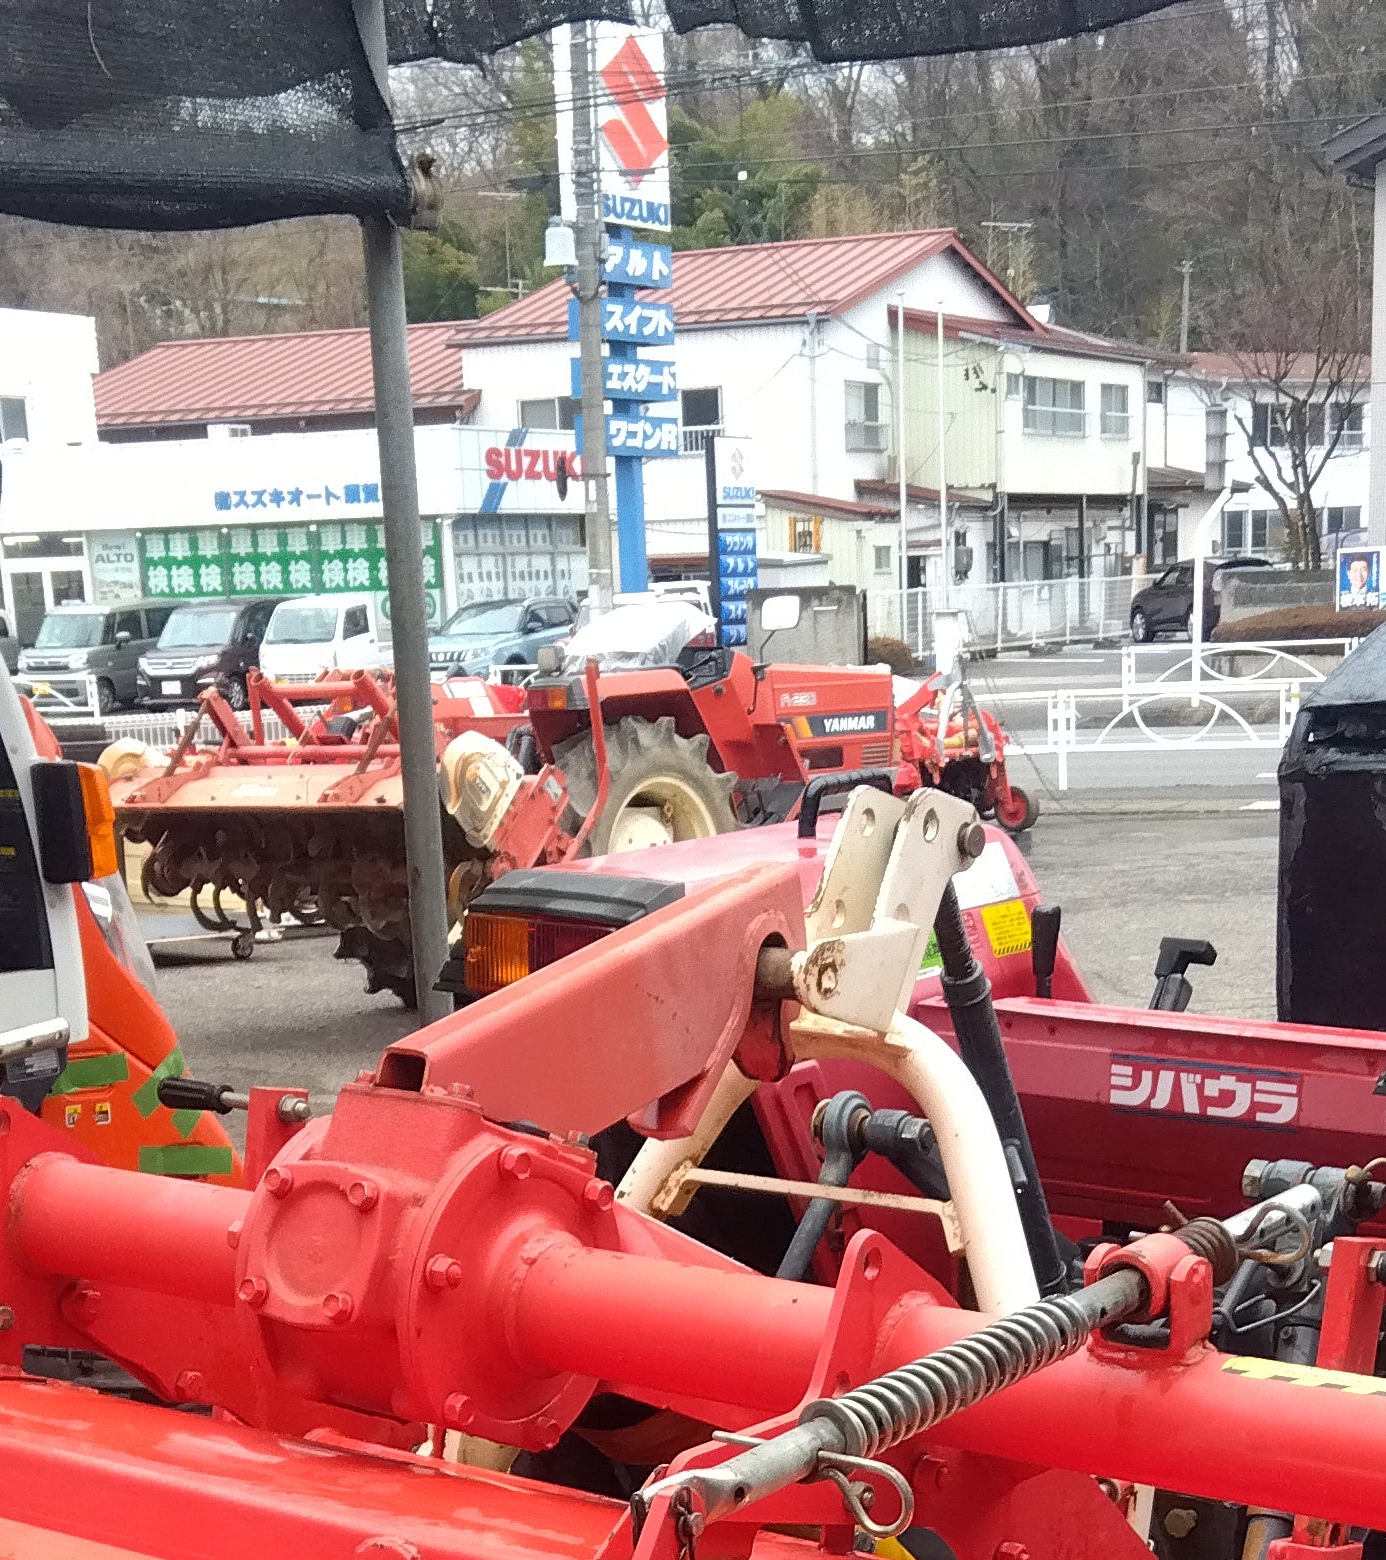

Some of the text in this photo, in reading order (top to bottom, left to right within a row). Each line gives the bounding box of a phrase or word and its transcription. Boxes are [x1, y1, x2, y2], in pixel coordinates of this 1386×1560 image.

[603, 193, 670, 226] SUZUKI
[604, 245, 670, 280] アルト
[605, 303, 674, 337] スイフト
[606, 363, 676, 395] エスクード
[609, 419, 678, 451] ワゴンR
[94, 552, 135, 564] ALTO
[824, 715, 876, 733] YANMAR
[1109, 1063, 1299, 1124] シバウラ
